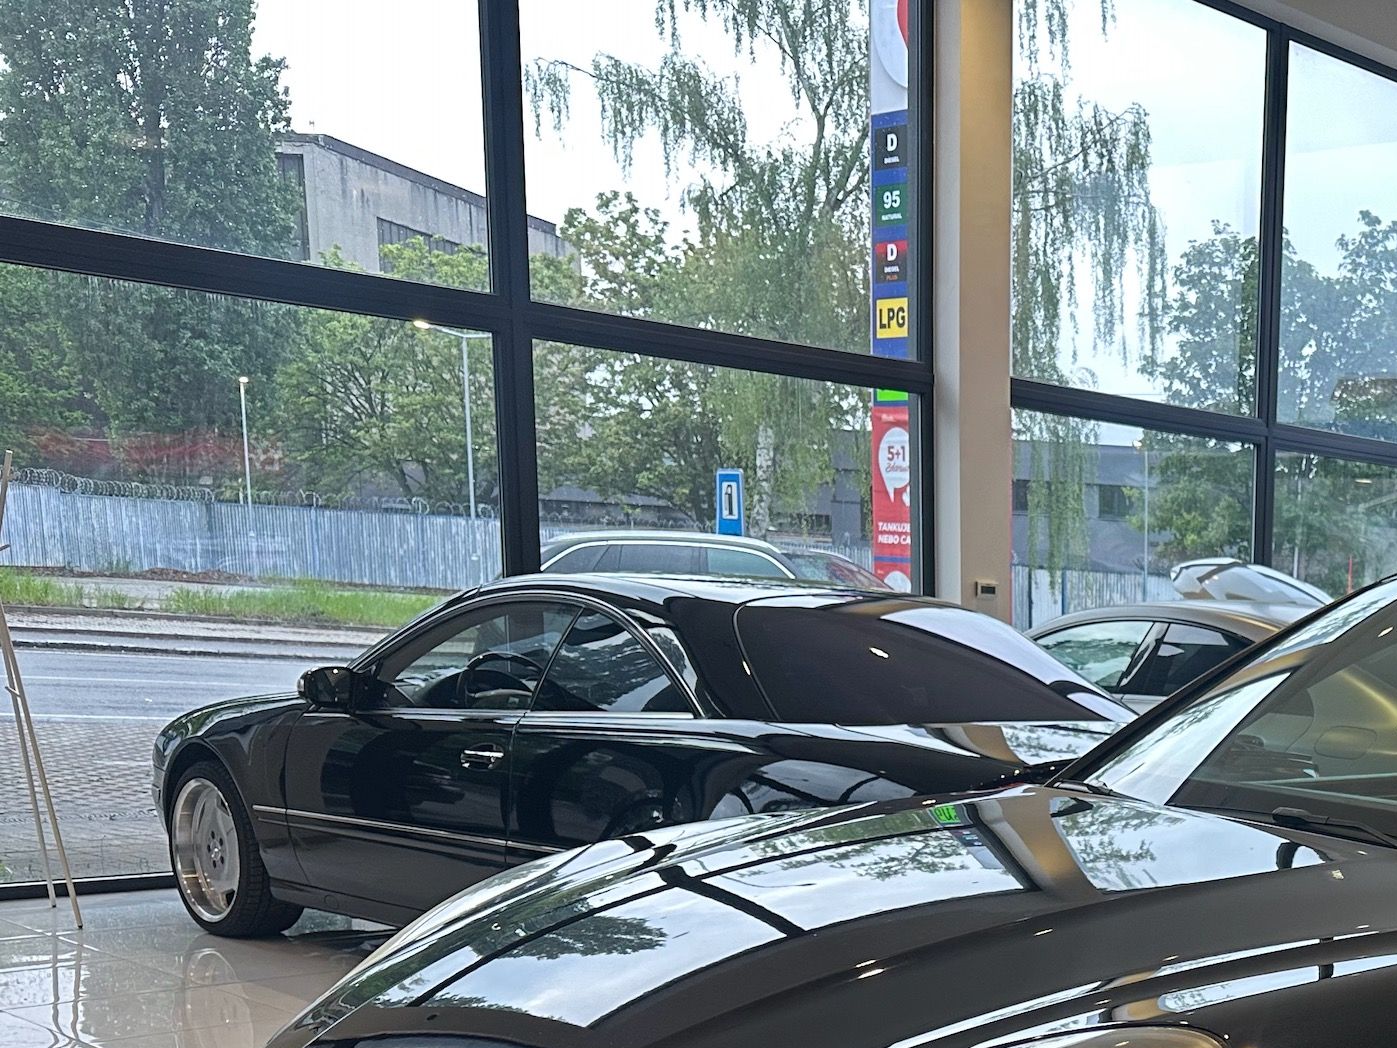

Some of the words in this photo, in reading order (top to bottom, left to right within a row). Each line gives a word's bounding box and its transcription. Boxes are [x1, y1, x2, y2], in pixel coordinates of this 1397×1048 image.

[886, 133, 898, 152] D
[883, 190, 901, 209] 95
[886, 243, 898, 262] D
[879, 306, 906, 330] LPG
[887, 445, 906, 462] 5+1
